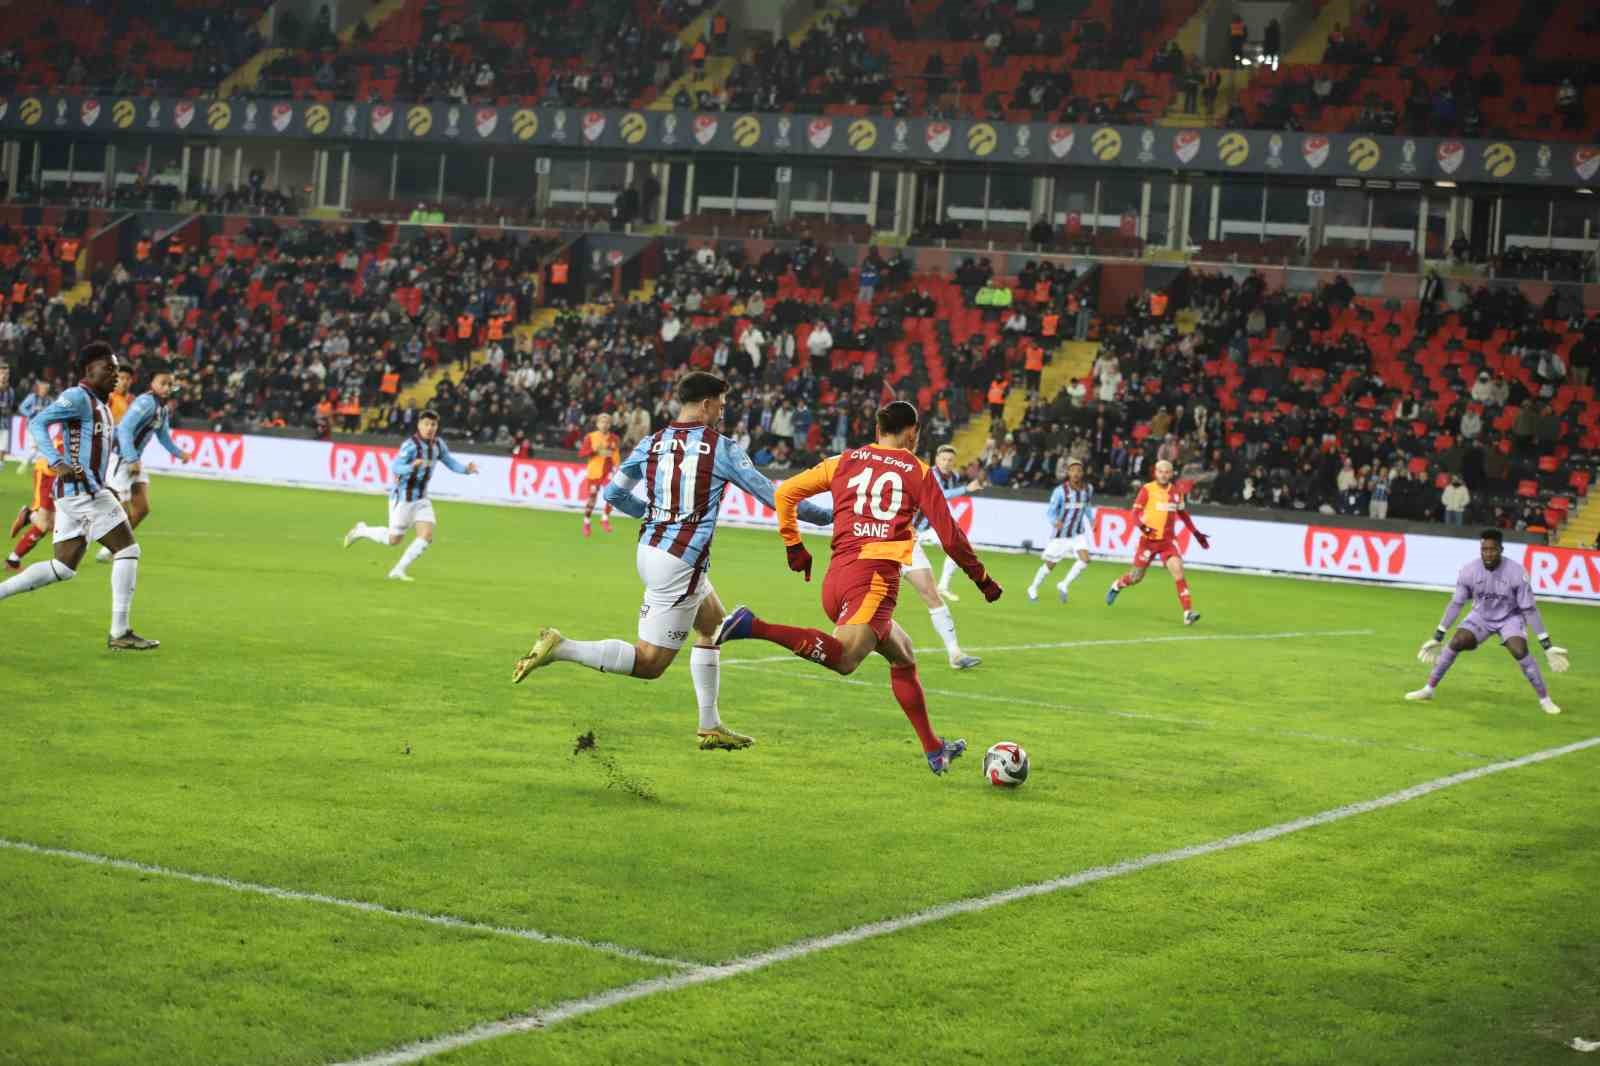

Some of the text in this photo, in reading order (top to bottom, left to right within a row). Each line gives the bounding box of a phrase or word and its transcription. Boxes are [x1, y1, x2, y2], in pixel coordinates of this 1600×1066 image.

[516, 463, 589, 502] RAY
[656, 451, 700, 514] 11
[847, 466, 903, 521] 10
[853, 522, 890, 538] SANE
[1312, 531, 1402, 579] RAY
